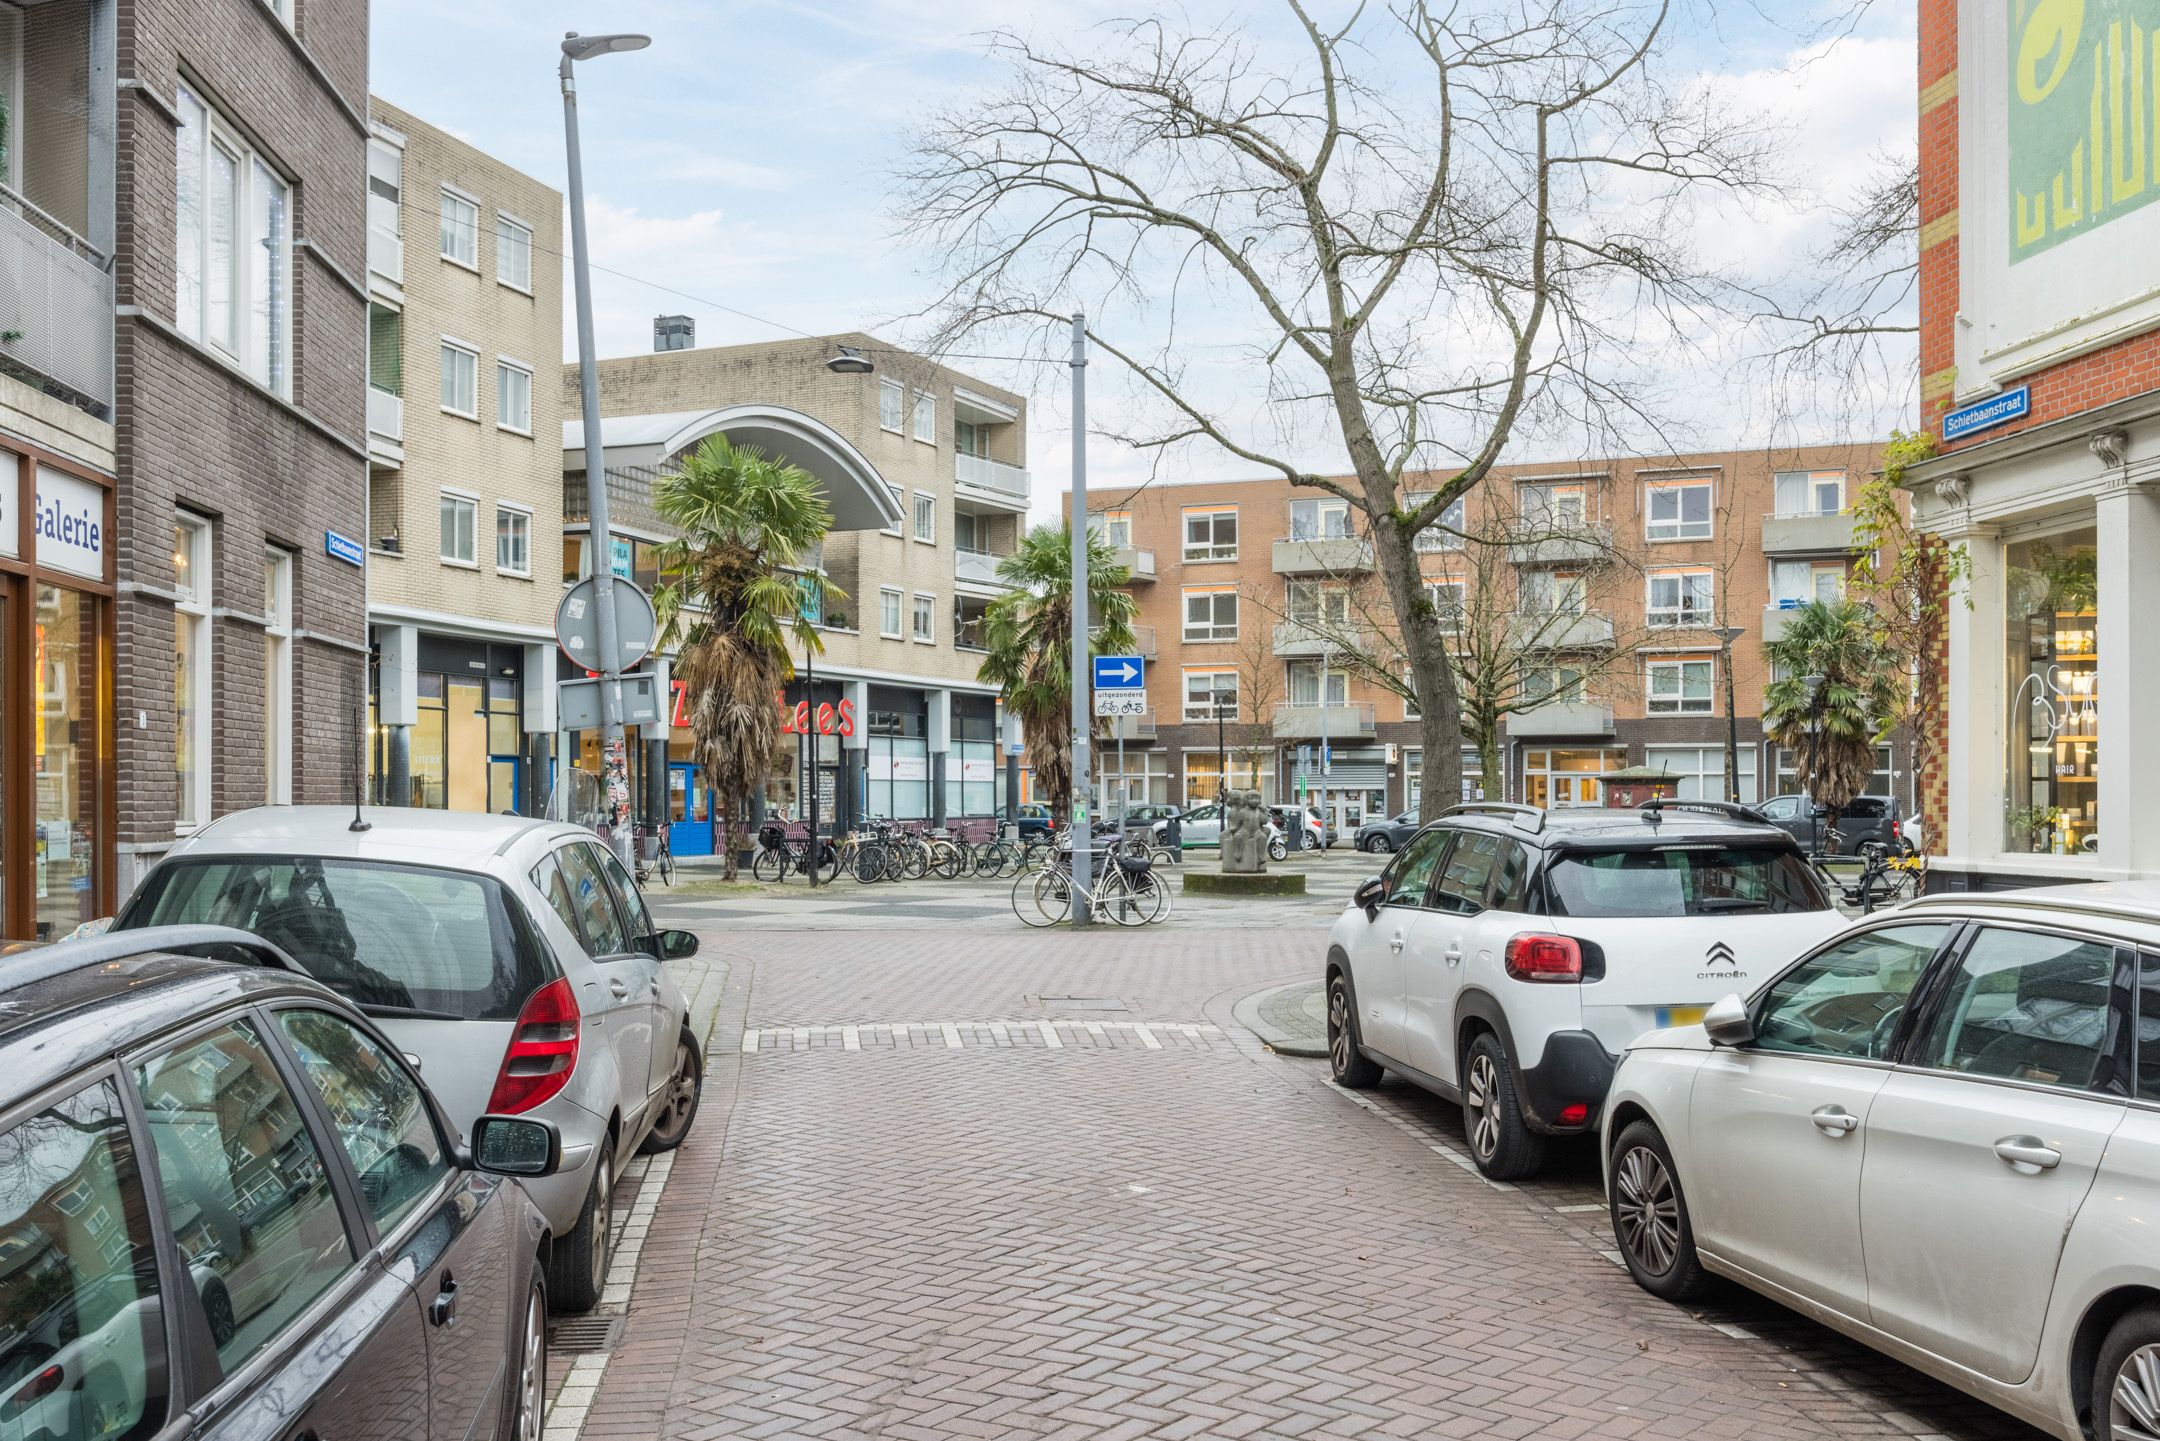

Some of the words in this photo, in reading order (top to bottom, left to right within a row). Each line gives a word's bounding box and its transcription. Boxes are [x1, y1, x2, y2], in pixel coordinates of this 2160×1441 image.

[1947, 395, 2022, 432] Schietbaanstraat
[1097, 691, 1143, 699] uitgezonderd
[2055, 764, 2075, 774] HAIR
